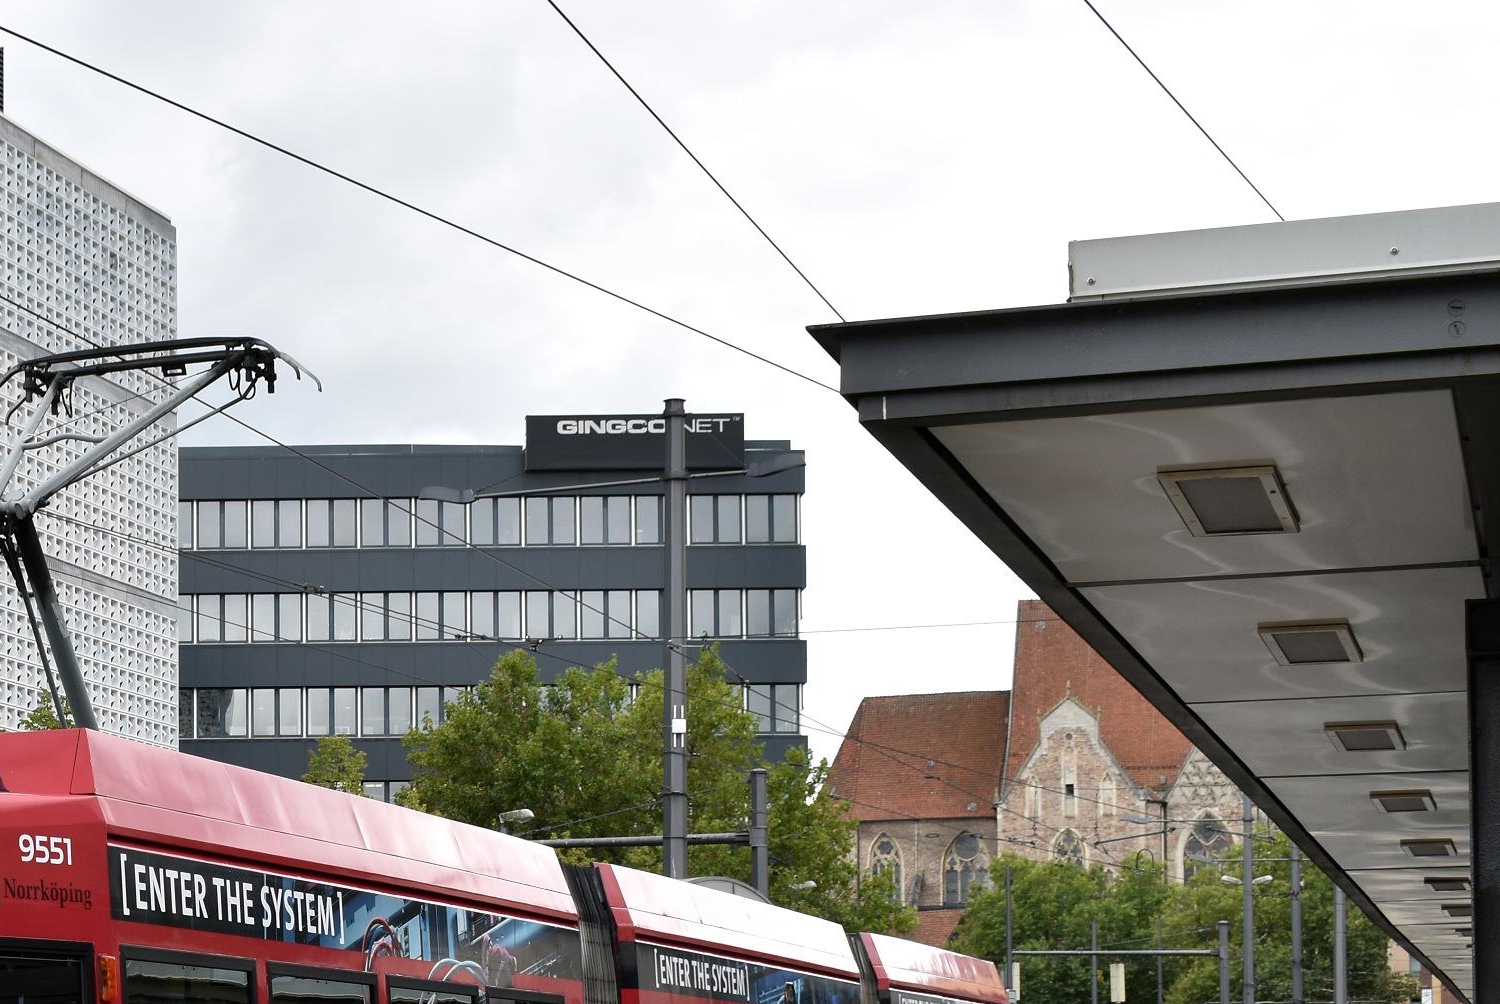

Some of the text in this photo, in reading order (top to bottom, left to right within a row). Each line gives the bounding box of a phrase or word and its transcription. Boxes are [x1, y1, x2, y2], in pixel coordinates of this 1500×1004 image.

[18, 833, 73, 866] 9551
[3, 878, 93, 911] Norrköping
[212, 877, 255, 926] THE
[691, 960, 711, 991] THE
